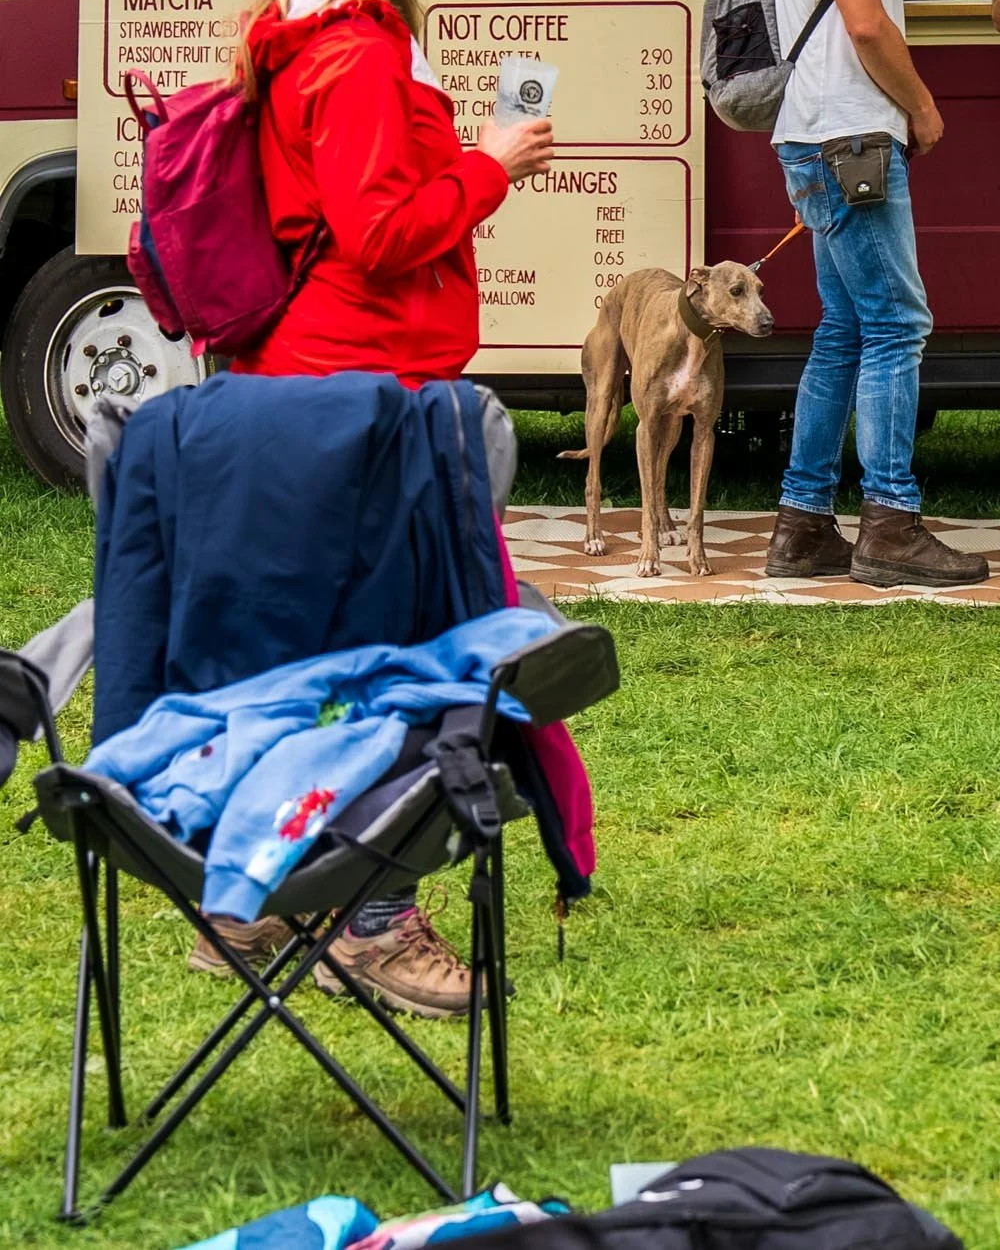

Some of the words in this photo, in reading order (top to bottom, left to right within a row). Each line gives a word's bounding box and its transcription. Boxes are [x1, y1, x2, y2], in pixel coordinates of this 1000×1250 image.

[120, 21, 204, 38] STRAWBERRY
[439, 15, 481, 40] NOT
[489, 15, 568, 41] COFFEE
[119, 46, 172, 63] PASSION
[177, 46, 211, 62] FRUIT
[641, 49, 672, 65] 2.90
[441, 75, 473, 91] EARL
[646, 74, 672, 90] 3.10
[640, 99, 672, 115] 3.90
[640, 124, 671, 140] 3.60
[530, 171, 617, 194] CHANGES
[597, 207, 624, 221] FREE!
[596, 229, 624, 244] FREE!
[594, 251, 624, 265] 0.65
[496, 269, 535, 283] CREAM
